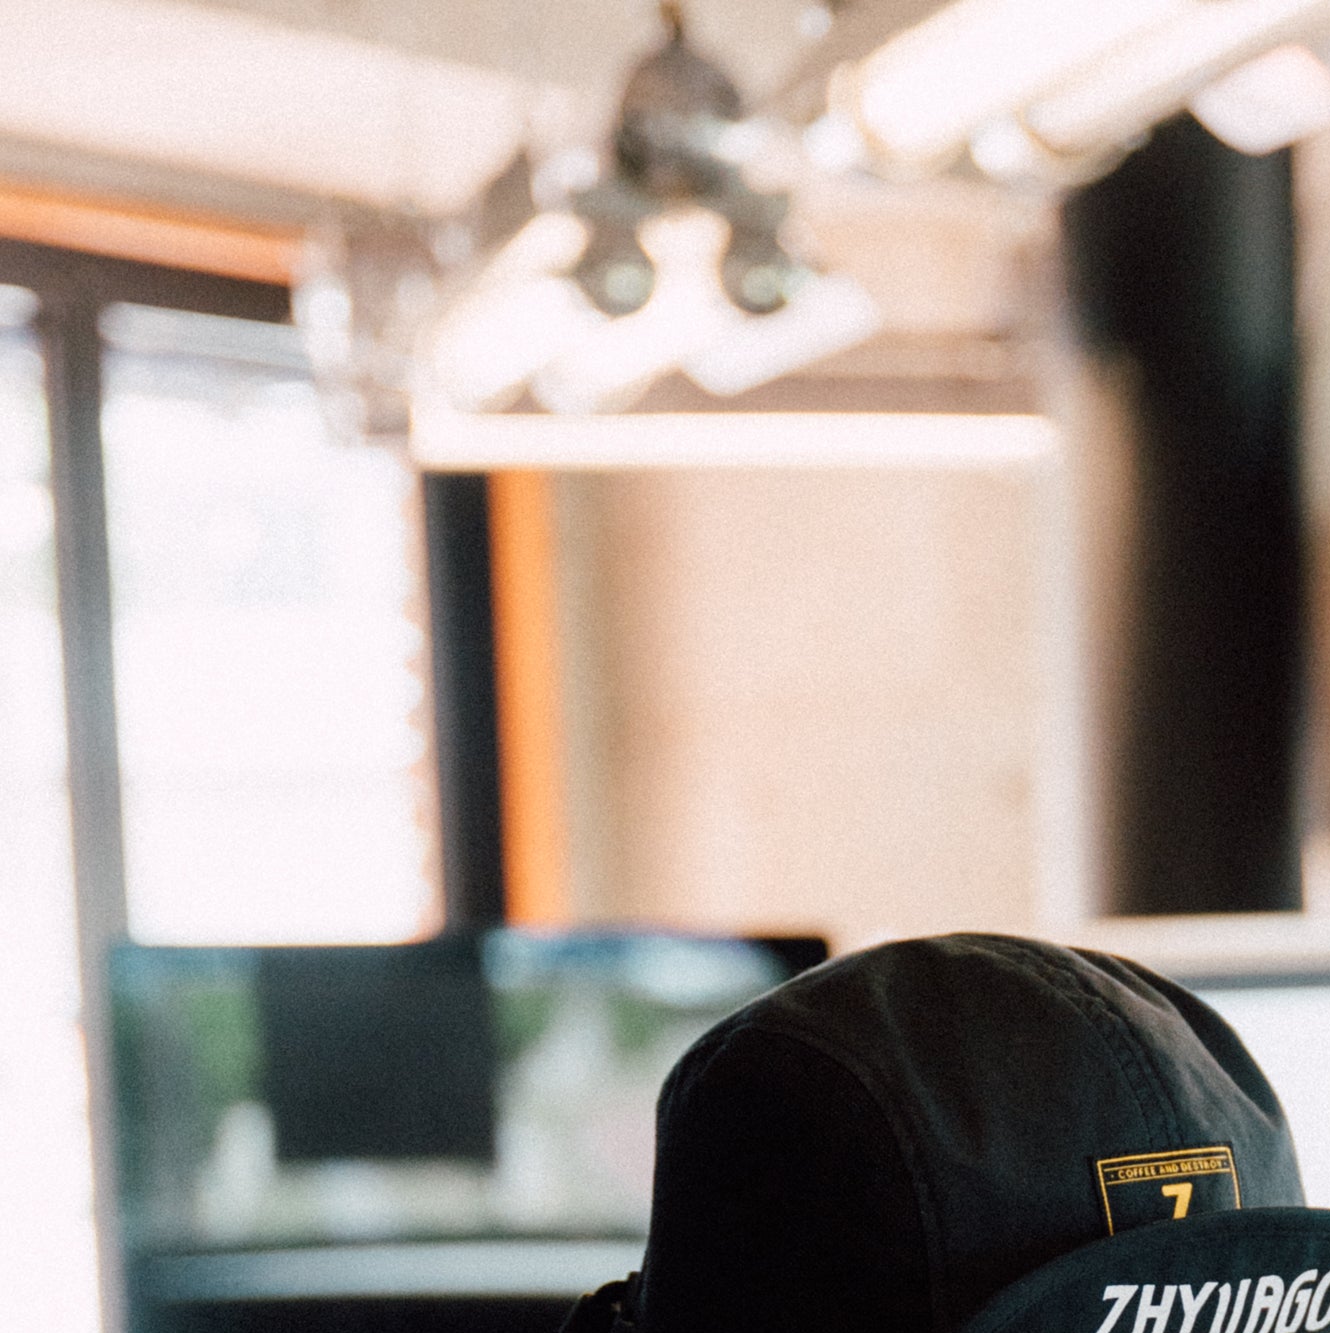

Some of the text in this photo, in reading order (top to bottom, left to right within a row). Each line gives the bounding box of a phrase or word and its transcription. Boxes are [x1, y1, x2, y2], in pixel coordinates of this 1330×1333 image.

[1118, 1160, 1223, 1180] COFFEE AND DESTROY
[1161, 1182, 1193, 1220] 7
